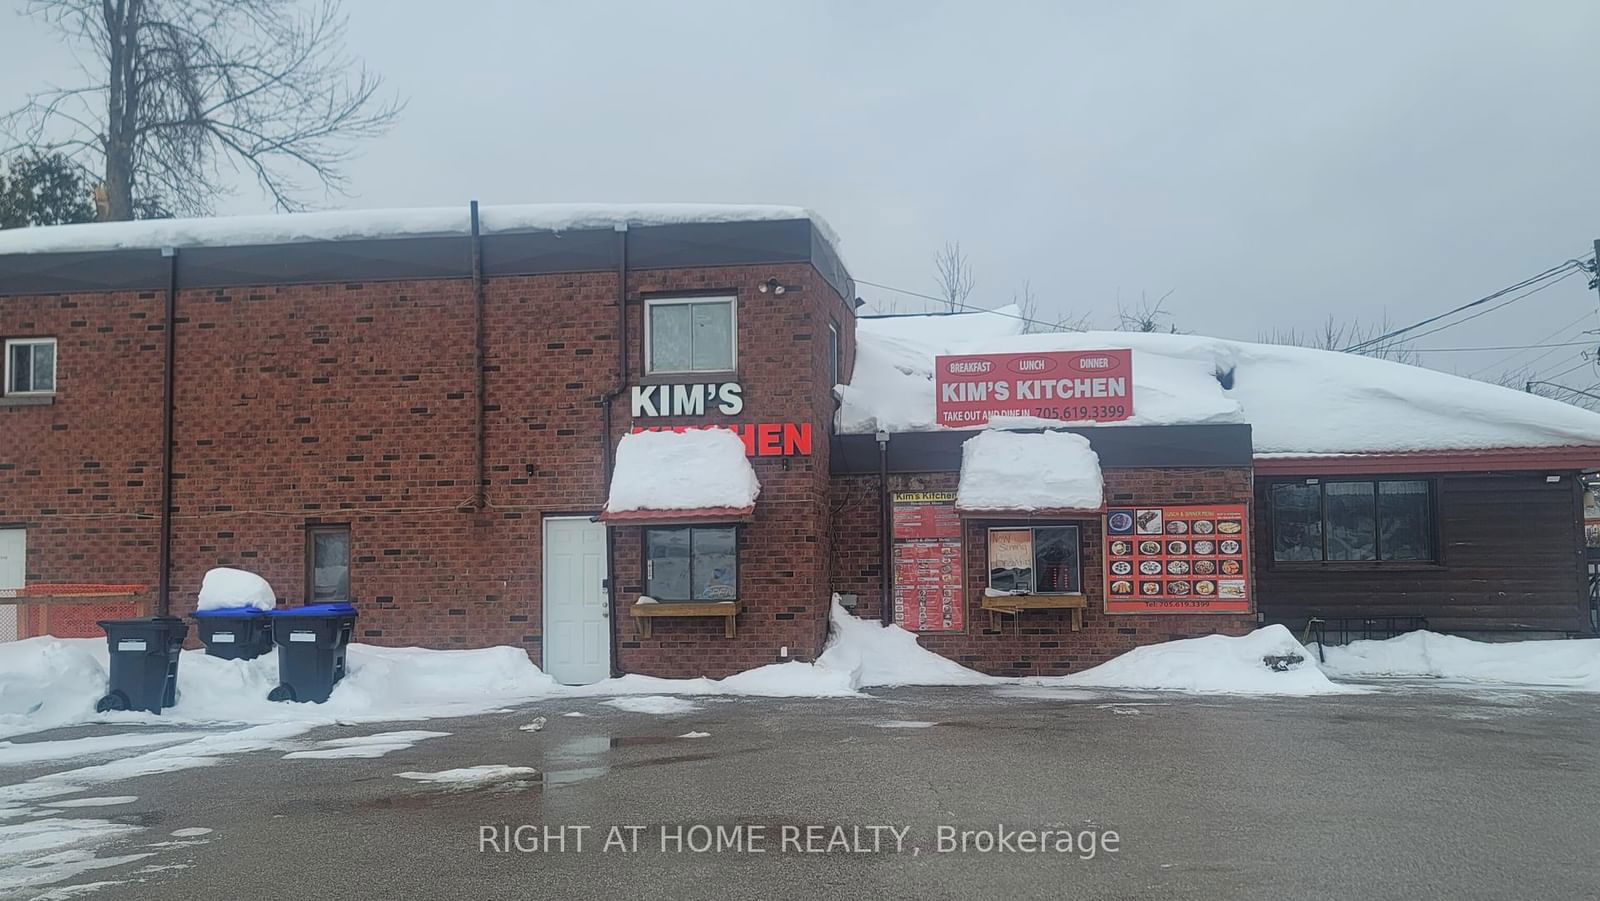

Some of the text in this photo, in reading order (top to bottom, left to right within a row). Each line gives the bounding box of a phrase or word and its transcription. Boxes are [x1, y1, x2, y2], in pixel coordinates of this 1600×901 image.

[950, 357, 1109, 373] BREAKFAST LUNCH DINNER
[631, 382, 743, 417] KIM'S
[942, 377, 1126, 402] KIM'S KITCHEN
[943, 411, 962, 421] TAKE
[964, 410, 981, 421] OUT
[982, 409, 1000, 420] AND
[1035, 405, 1125, 419] 705.619.3399
